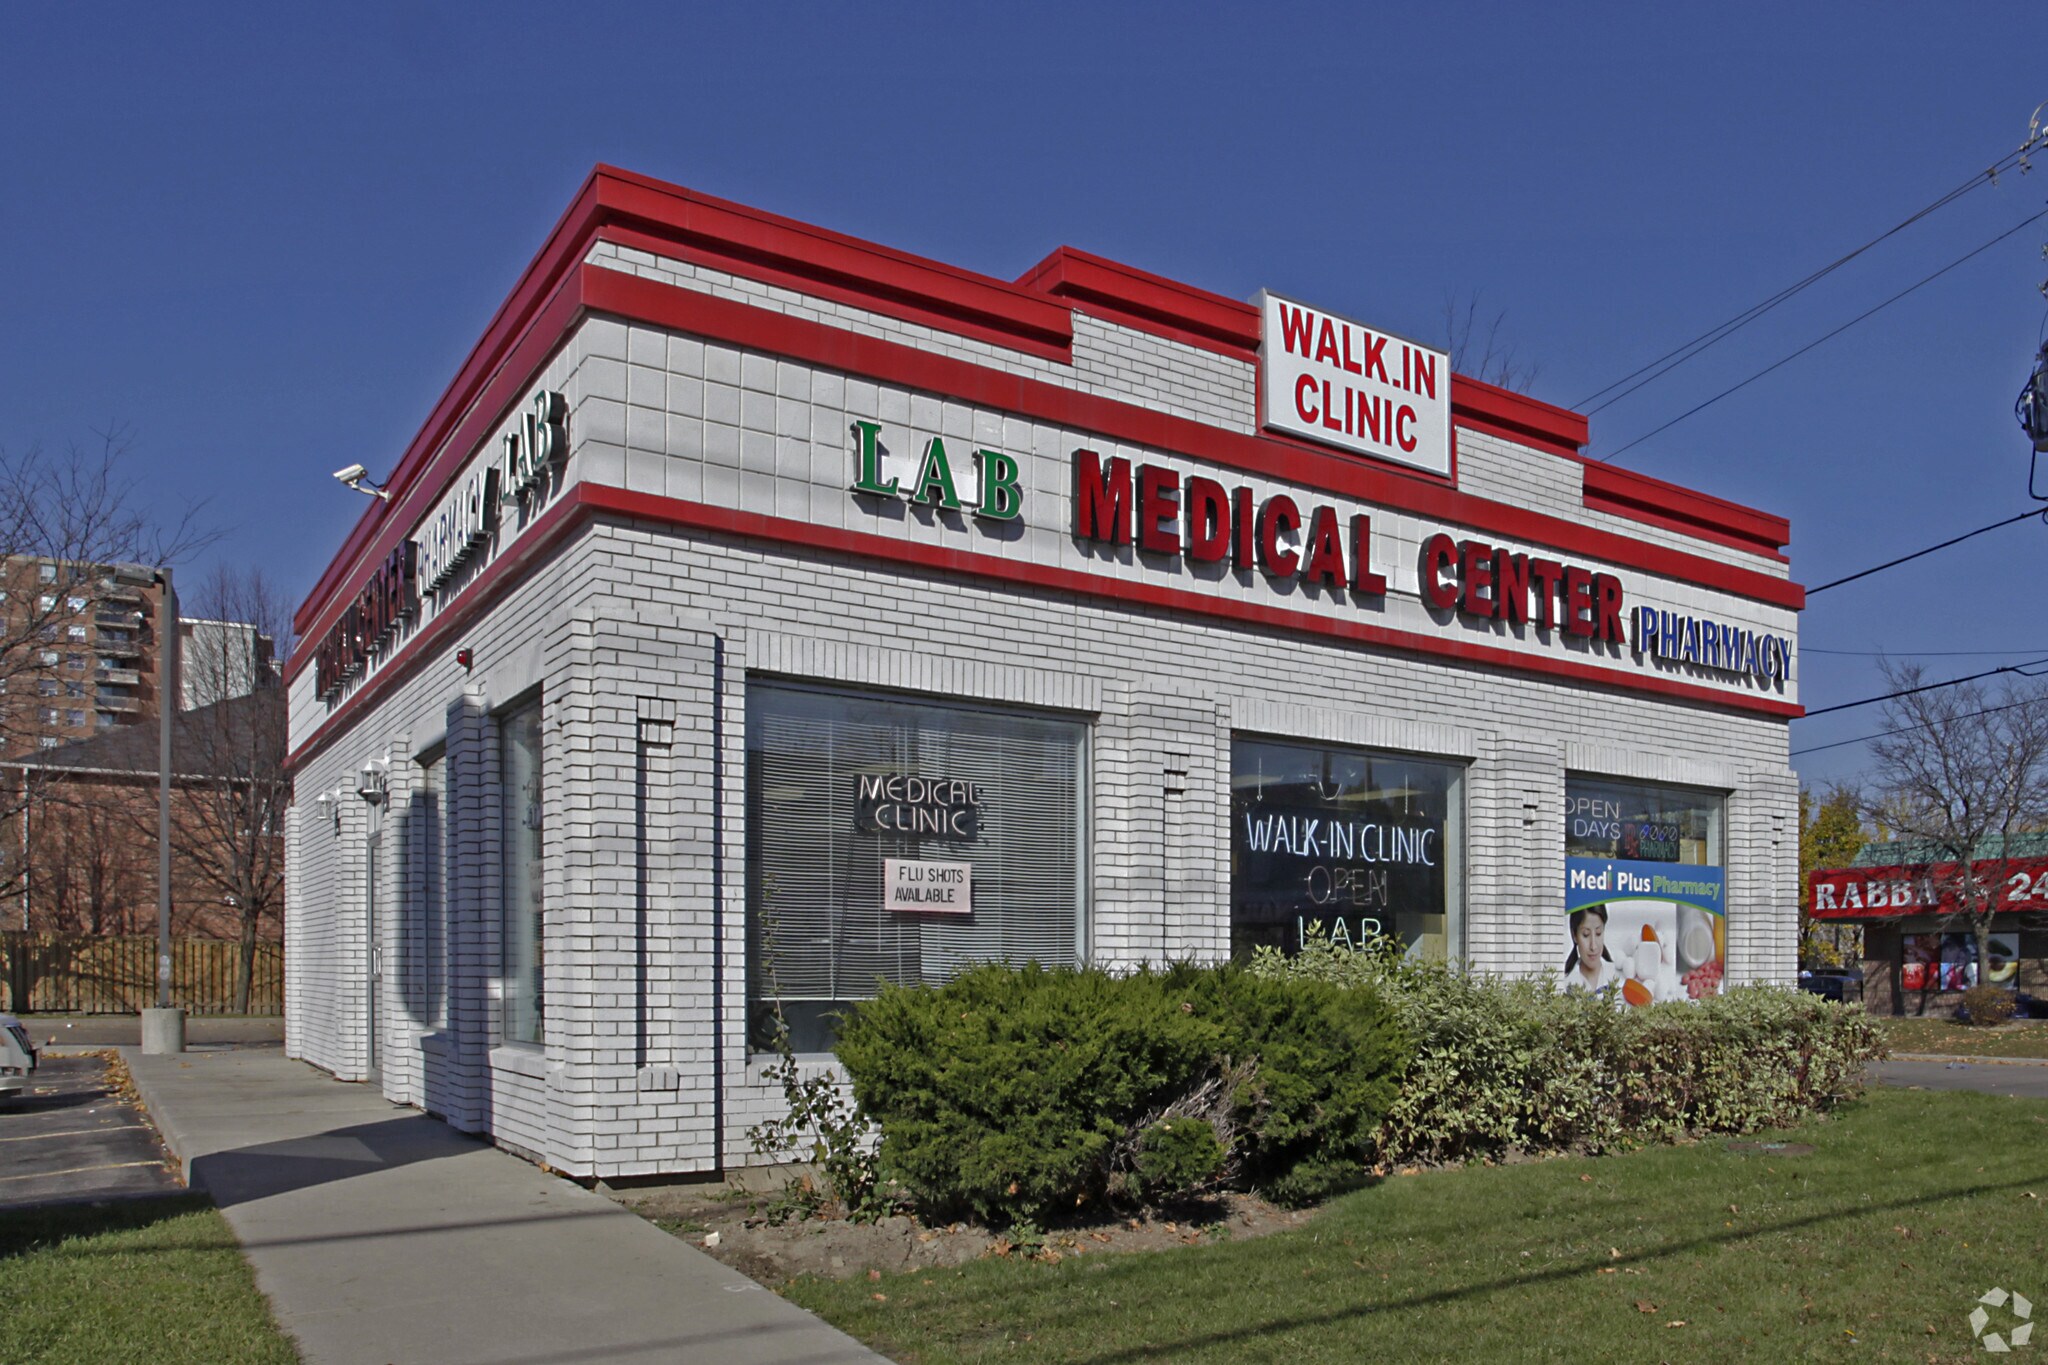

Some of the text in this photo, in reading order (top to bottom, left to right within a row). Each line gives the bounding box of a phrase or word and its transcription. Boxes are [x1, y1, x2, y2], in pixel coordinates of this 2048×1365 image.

[1294, 373, 1418, 453] CLINIC
[502, 389, 567, 506] LAB
[851, 420, 1021, 520] LAB
[1072, 448, 1793, 681] MEDICAL CENTER PHARMACY
[859, 774, 980, 806] MEDICAL
[875, 804, 967, 835] CLINIC
[1574, 819, 1621, 840] DAYS
[1246, 812, 1436, 866] WALK-IN CLINIC
[899, 866, 964, 884] FLU SHOTS
[1307, 866, 1388, 906] OPEN
[1570, 864, 1721, 901] Medi Plus Pharmacy
[894, 887, 955, 903] AVAILABLE
[1815, 878, 1940, 910] RABBA
[1299, 915, 1384, 952] LAB
